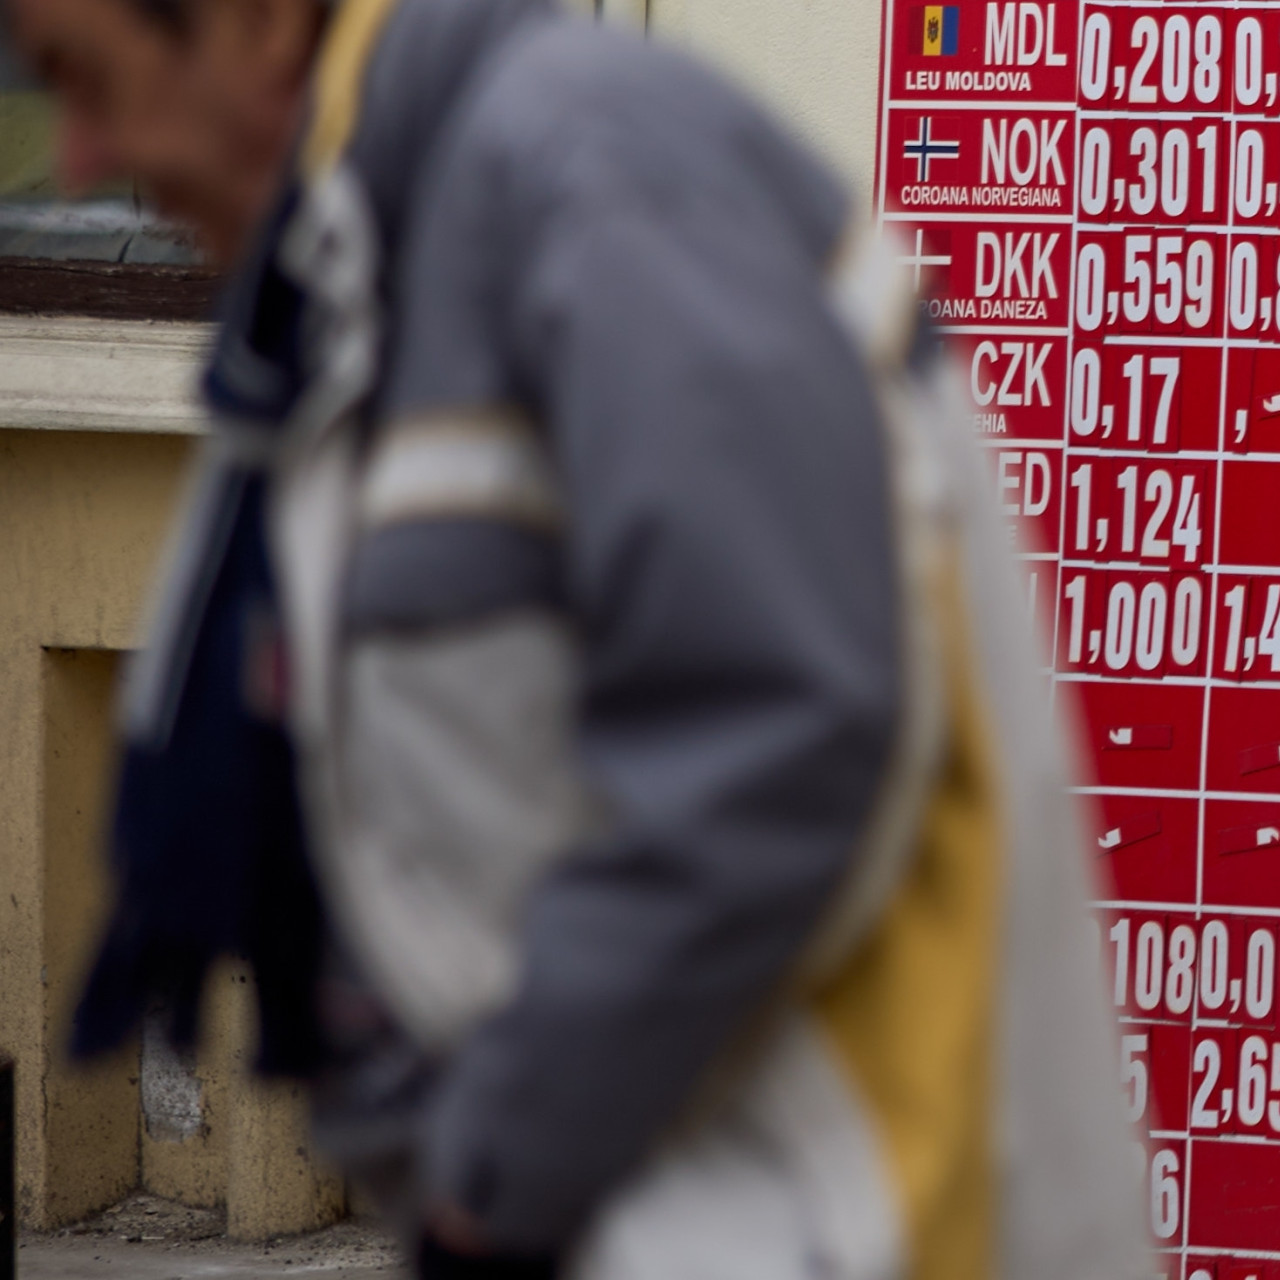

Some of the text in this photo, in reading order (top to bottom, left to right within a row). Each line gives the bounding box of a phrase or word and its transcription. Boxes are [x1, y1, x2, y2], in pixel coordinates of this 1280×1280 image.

[906, 71, 1032, 92] LEU MOLDOVA
[983, 2, 1067, 68] MDL
[1081, 12, 1221, 104] 0,208
[901, 185, 1061, 207] COROANA NORVEGIANA
[981, 117, 1067, 186] NOK
[1080, 125, 1218, 217] 0,301
[919, 298, 1047, 320] ROANA DANEZA
[975, 231, 1061, 301] DKK
[1077, 234, 1214, 332] 0,559
[971, 340, 1181, 446] CZK 0,17
[972, 413, 1007, 433] EHIA
[1002, 451, 1201, 563] ED 1,124
[1065, 575, 1201, 672] 1,000
